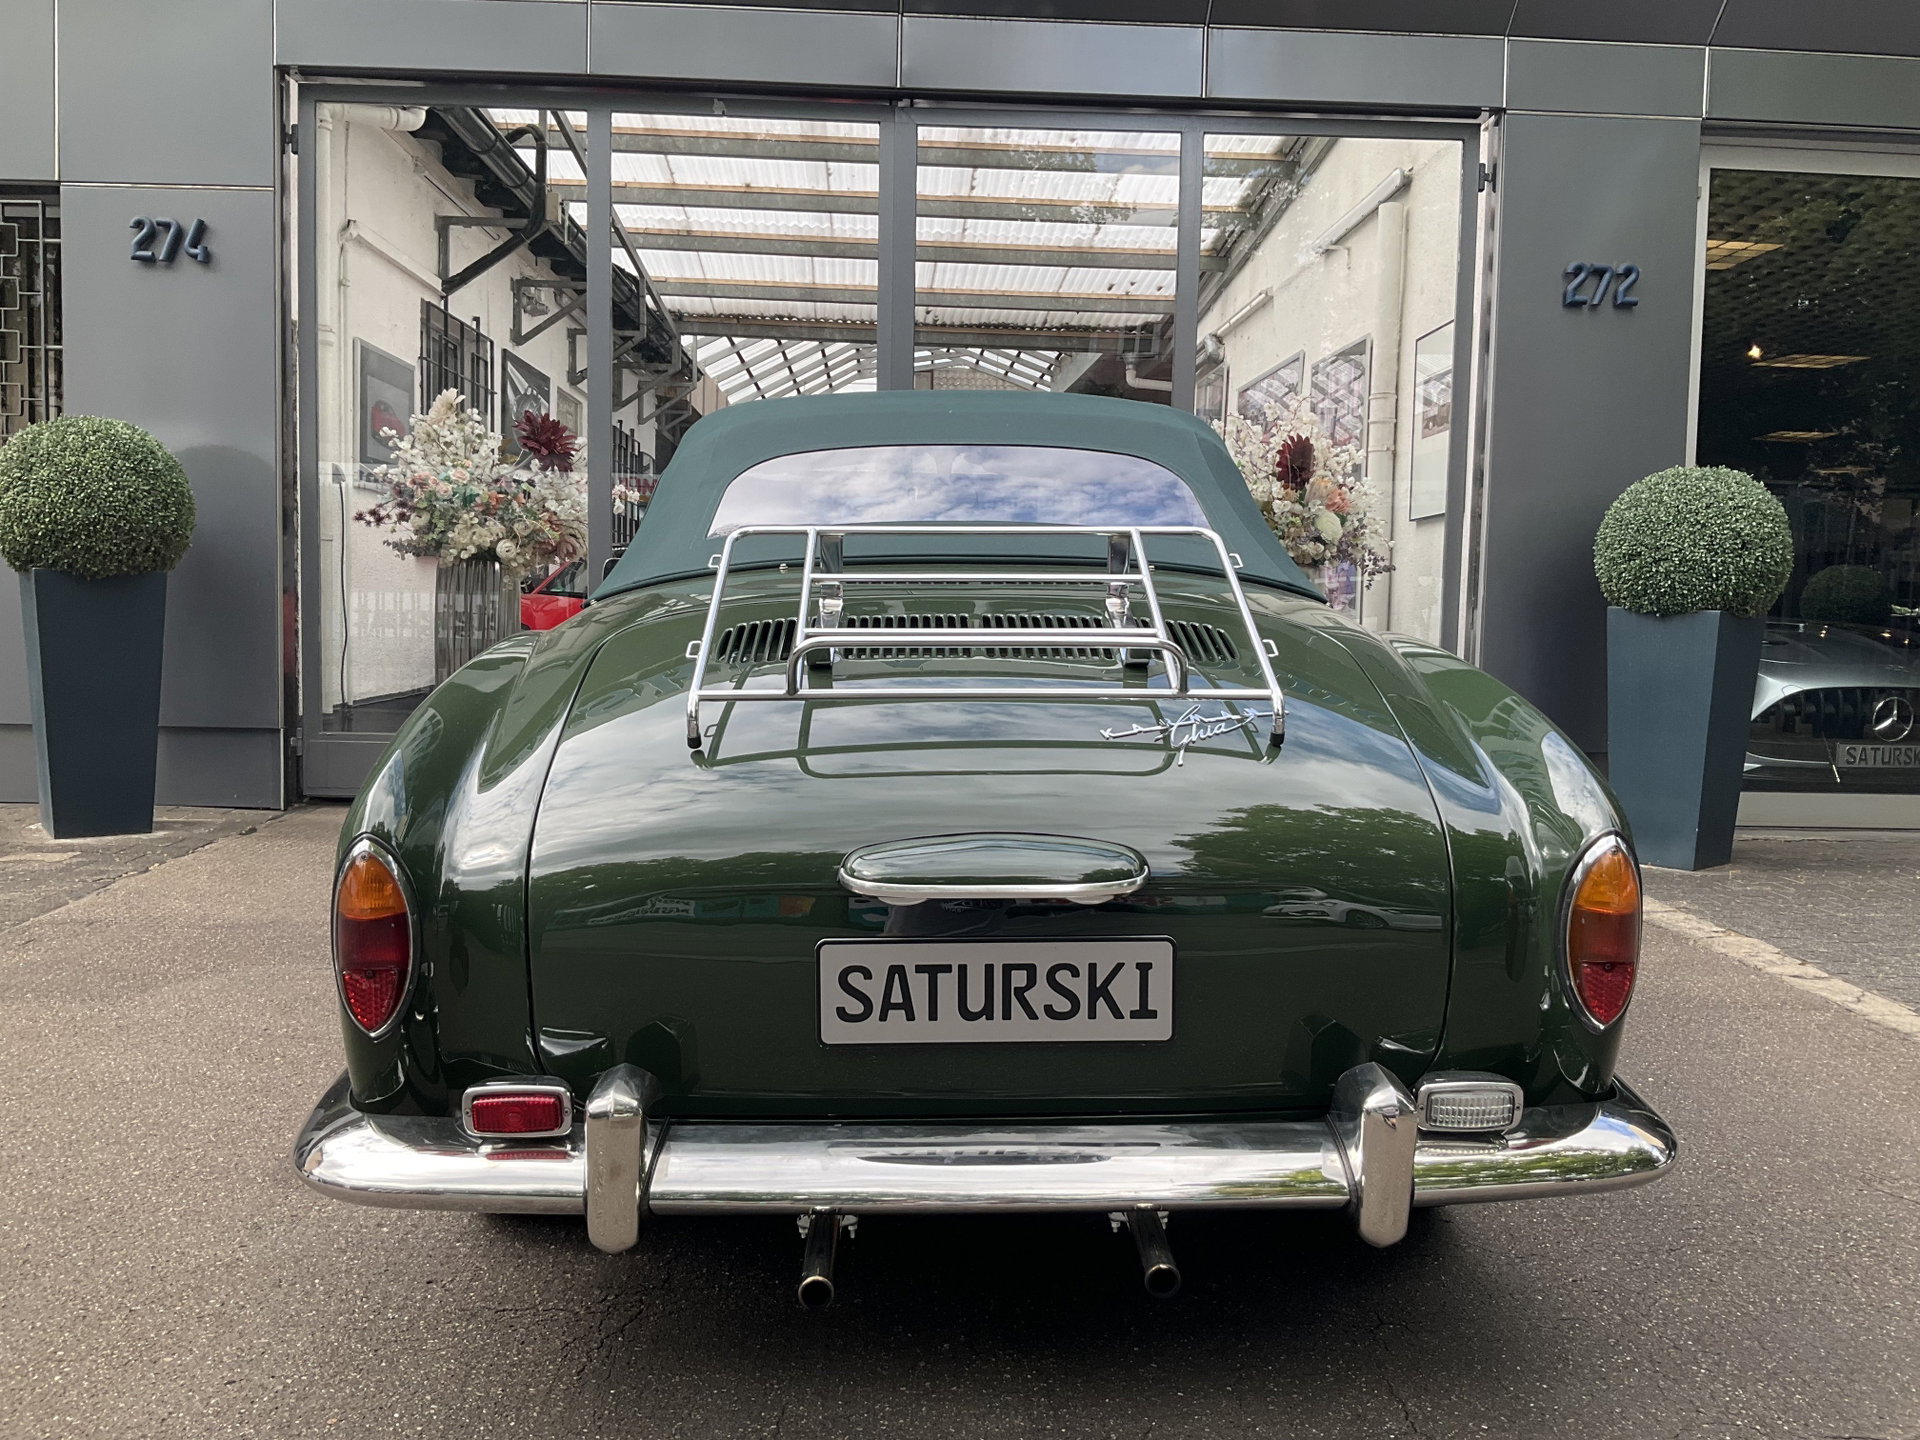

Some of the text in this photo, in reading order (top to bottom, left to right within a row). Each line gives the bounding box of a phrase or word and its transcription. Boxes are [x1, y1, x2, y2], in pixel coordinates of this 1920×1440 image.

[129, 216, 209, 263] 274
[1563, 263, 1640, 308] 272
[835, 962, 1158, 1023] SATURSKI
